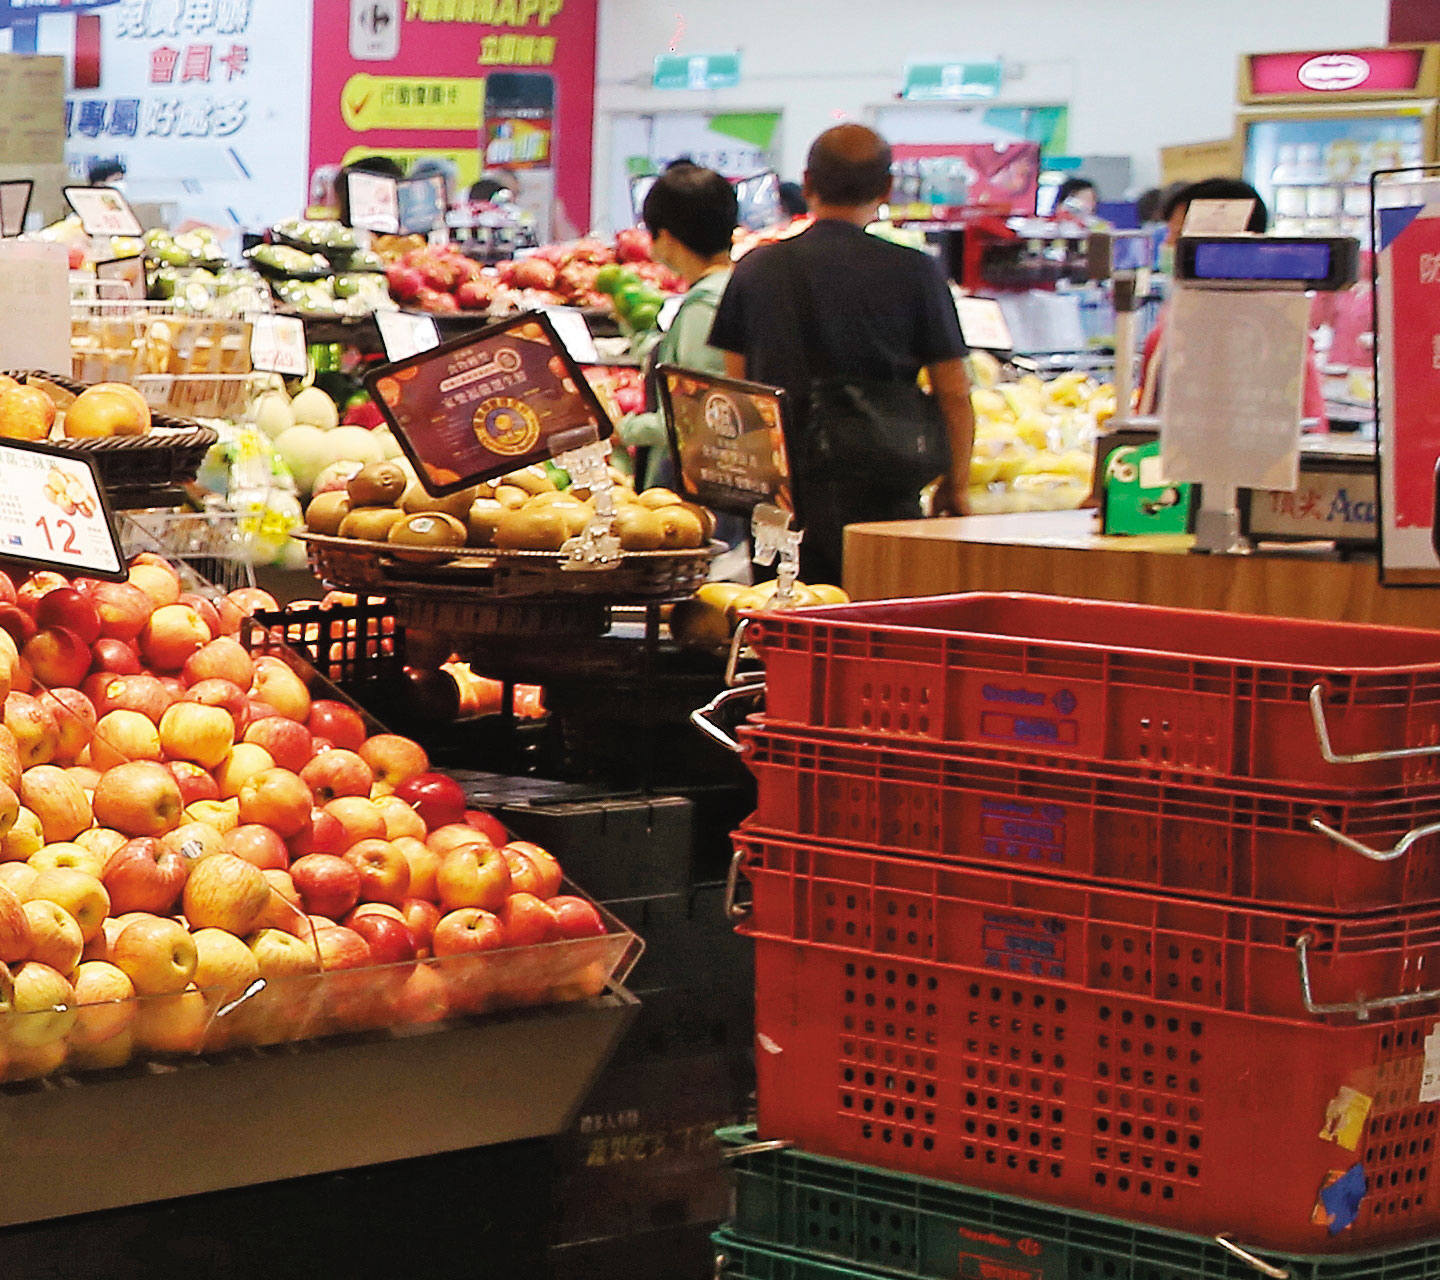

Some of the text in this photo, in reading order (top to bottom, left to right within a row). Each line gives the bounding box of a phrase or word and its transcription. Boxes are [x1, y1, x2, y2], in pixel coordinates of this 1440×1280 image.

[150, 45, 249, 83] 會員卡
[36, 516, 82, 555] 12
